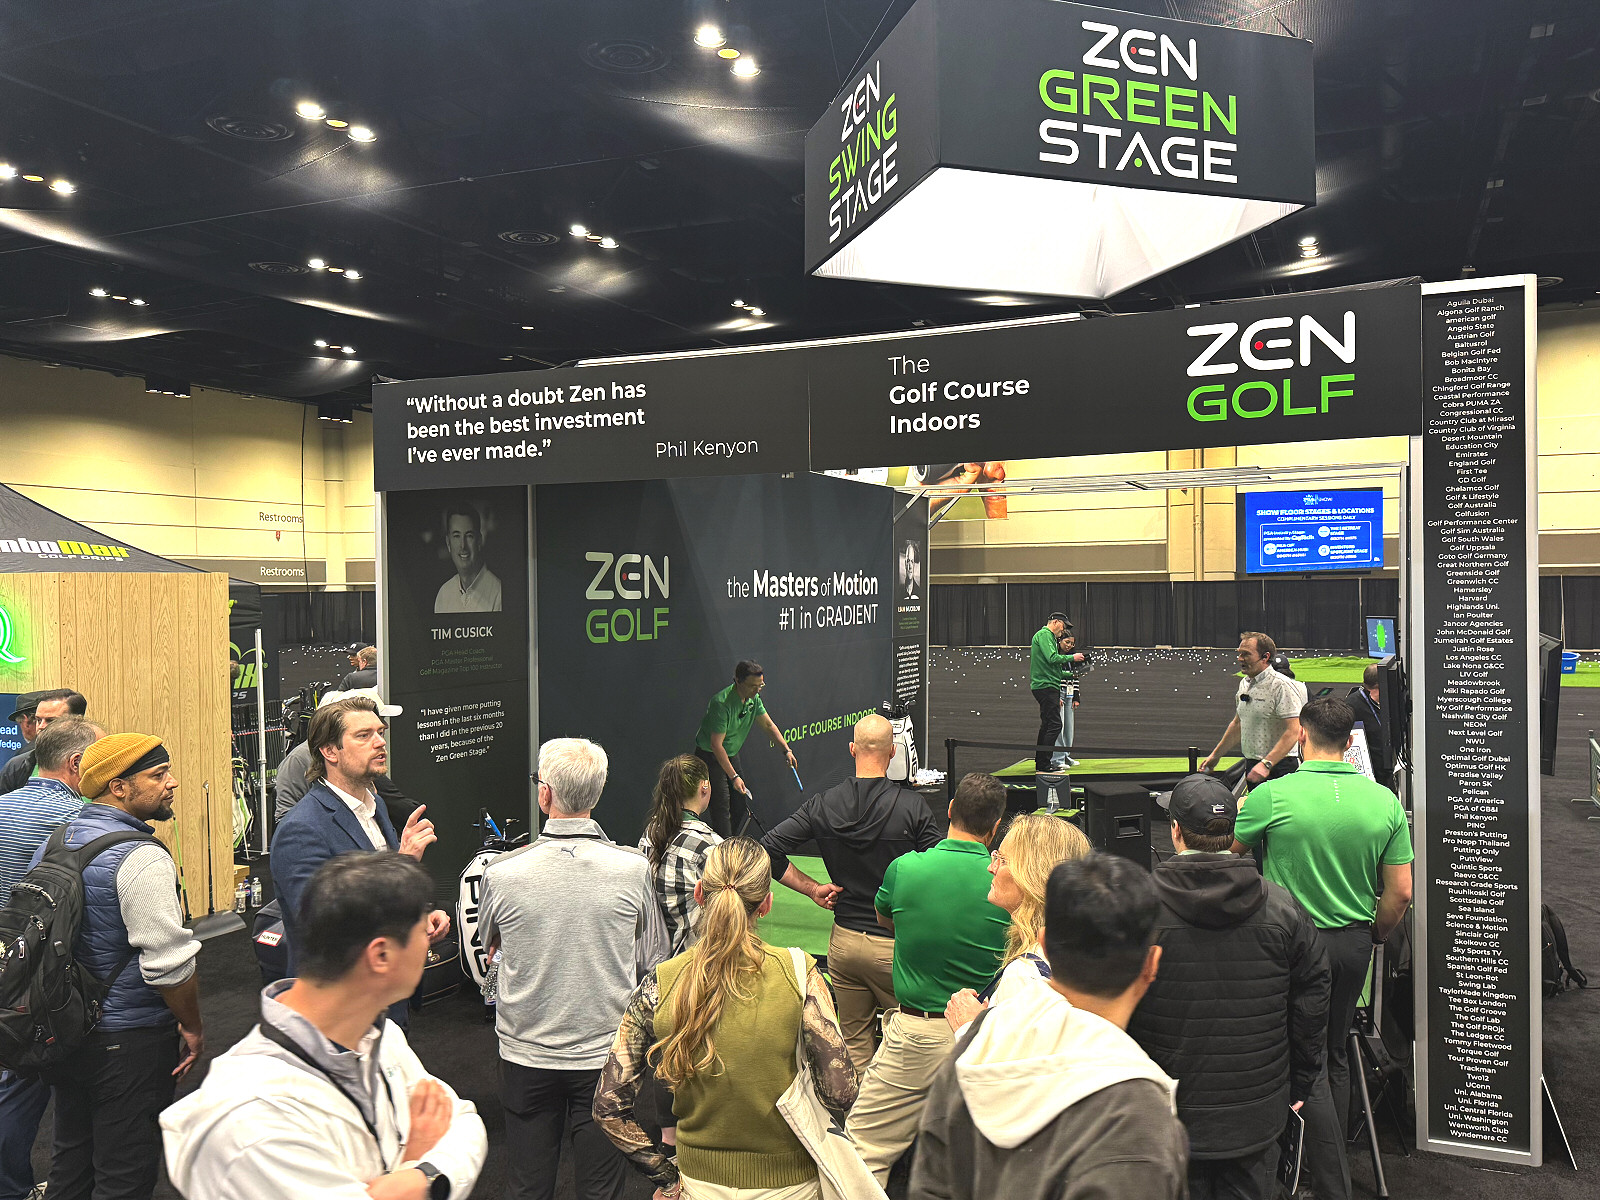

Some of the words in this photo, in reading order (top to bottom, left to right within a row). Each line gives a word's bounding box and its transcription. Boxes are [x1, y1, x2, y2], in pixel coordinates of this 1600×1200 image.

[1081, 21, 1198, 81] ZEN
[841, 61, 881, 142] ZEN
[1038, 70, 1237, 135] GREEN
[829, 93, 897, 200] SWING
[1038, 119, 1238, 184] STAGE
[829, 141, 898, 244] STAGE
[1437, 308, 1462, 316] Algona
[1481, 304, 1504, 312] Ranch
[1186, 310, 1356, 377] ZEN
[1454, 339, 1487, 348] Baltusrol
[888, 355, 929, 375] The
[493, 395, 502, 407] a
[508, 387, 564, 406] doubt
[570, 385, 605, 402] Zen
[612, 382, 646, 399] has
[890, 382, 937, 404] Golf
[944, 380, 1029, 400] Course
[1187, 373, 1355, 422] GOLF
[1440, 407, 1491, 417] Congressional
[408, 423, 449, 438] been
[455, 419, 484, 435] the
[490, 416, 530, 433] best
[535, 409, 645, 430] investment
[891, 413, 980, 433] Indoors
[1486, 423, 1515, 432] Virginia
[442, 447, 480, 461] ever
[657, 441, 686, 457] Phil
[694, 441, 757, 458] Kenyon
[260, 512, 303, 523] Restrooms
[260, 566, 304, 577] Restrooms
[586, 552, 669, 599] ZEN
[727, 576, 749, 597] the
[754, 570, 818, 597] Masters
[821, 578, 831, 596] of
[834, 570, 878, 596] Motion
[779, 608, 794, 630] #1
[801, 606, 811, 629] in
[817, 604, 878, 627] GRADIENT
[431, 629, 451, 639] TIM
[455, 626, 492, 638] CUSICK
[586, 608, 669, 643] GOLF
[444, 706, 461, 714] given
[480, 700, 501, 710] putting
[1438, 695, 1481, 703] Myerscough
[1483, 696, 1510, 704] College
[417, 720, 441, 729] lessons
[483, 710, 504, 719] months
[419, 733, 434, 741] than
[470, 723, 495, 734] previous
[784, 725, 807, 743] GOLF
[810, 716, 842, 736] COURSE
[430, 742, 449, 753] years,
[451, 738, 476, 747] because
[450, 751, 467, 760] Green
[1470, 813, 1497, 822] Kenyon
[1453, 846, 1480, 855] Putting
[1482, 847, 1499, 856] Only
[1478, 864, 1502, 872] Sports
[1465, 913, 1507, 923] Foundation
[1446, 953, 1479, 962] Southern
[1439, 986, 1480, 996] TaylorMade
[1482, 990, 1516, 1000] Kingdom
[1459, 1063, 1496, 1073] Trackman
[1466, 1080, 1490, 1090] UConn
[1474, 1098, 1498, 1107] Florida
